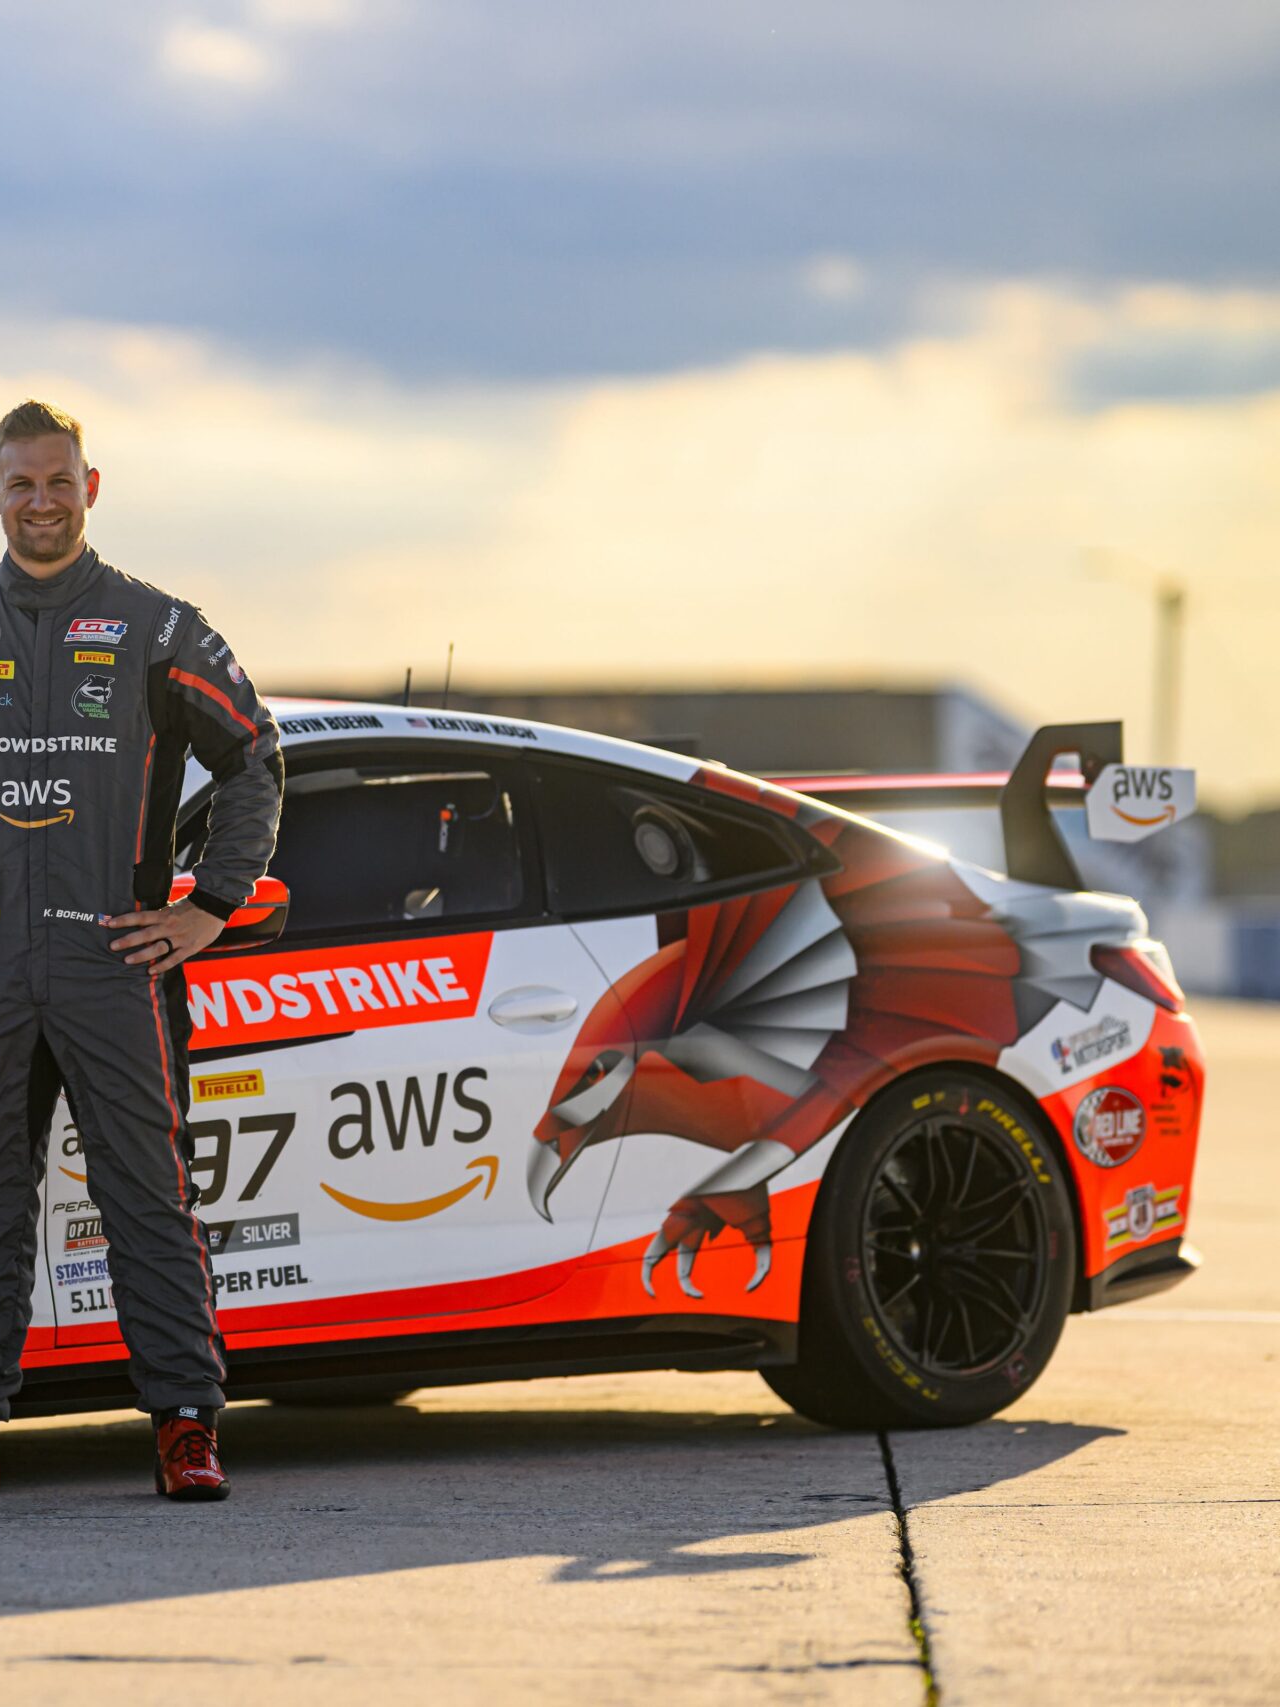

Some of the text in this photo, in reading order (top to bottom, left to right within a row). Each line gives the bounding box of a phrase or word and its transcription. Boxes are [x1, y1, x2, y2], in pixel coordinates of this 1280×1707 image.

[81, 634, 118, 642] AMERICA
[158, 607, 181, 646] Sabelt
[77, 653, 113, 663] PIRELLI
[279, 715, 384, 735] KEVIN BOEHM
[426, 717, 538, 740] KENTON KOCH
[1, 778, 71, 806] aws
[1112, 768, 1173, 803] aws
[43, 908, 94, 922] K. BOEHM
[186, 957, 470, 1031] WDSTRIKE
[197, 1074, 258, 1098] PIRELLI
[326, 1067, 493, 1160] aws
[189, 1112, 297, 1207] 97
[68, 1220, 103, 1239] OPTI
[242, 1222, 292, 1243] SILVER
[257, 1265, 308, 1289] FUEL
[70, 1288, 108, 1313] 5.11
[179, 1407, 198, 1417] OMP
